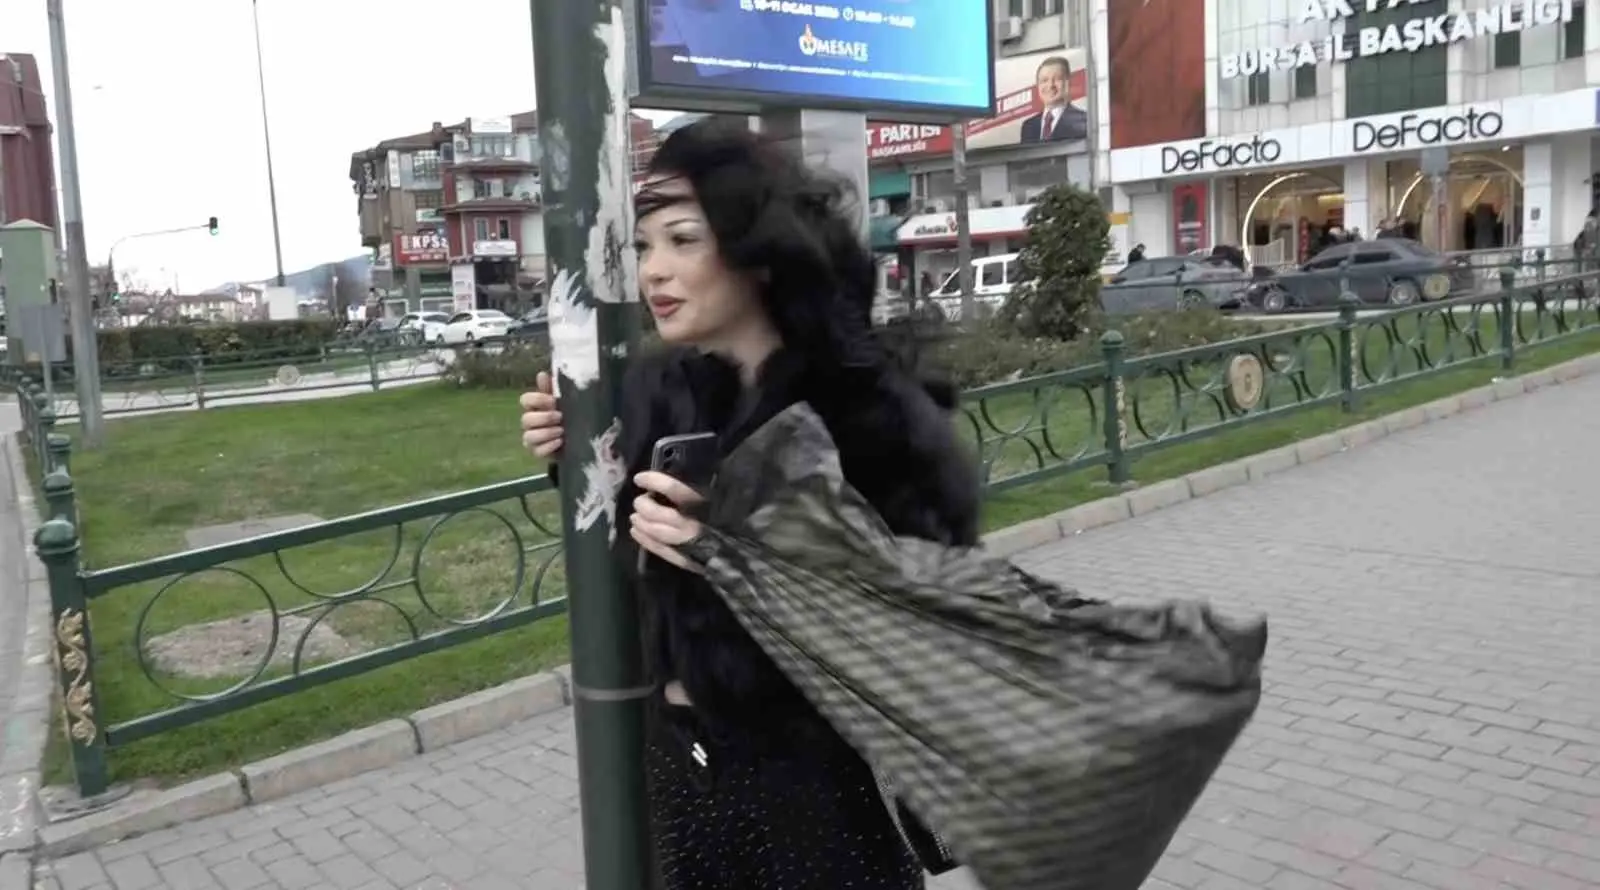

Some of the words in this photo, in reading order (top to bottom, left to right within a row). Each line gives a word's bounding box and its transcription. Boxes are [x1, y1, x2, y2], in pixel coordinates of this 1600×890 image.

[1221, 43, 1316, 79] BURSA
[1359, 0, 1574, 57] BAŞKANLIĞI
[1353, 106, 1503, 152] DeFacto
[1161, 135, 1281, 174] DeFacto
